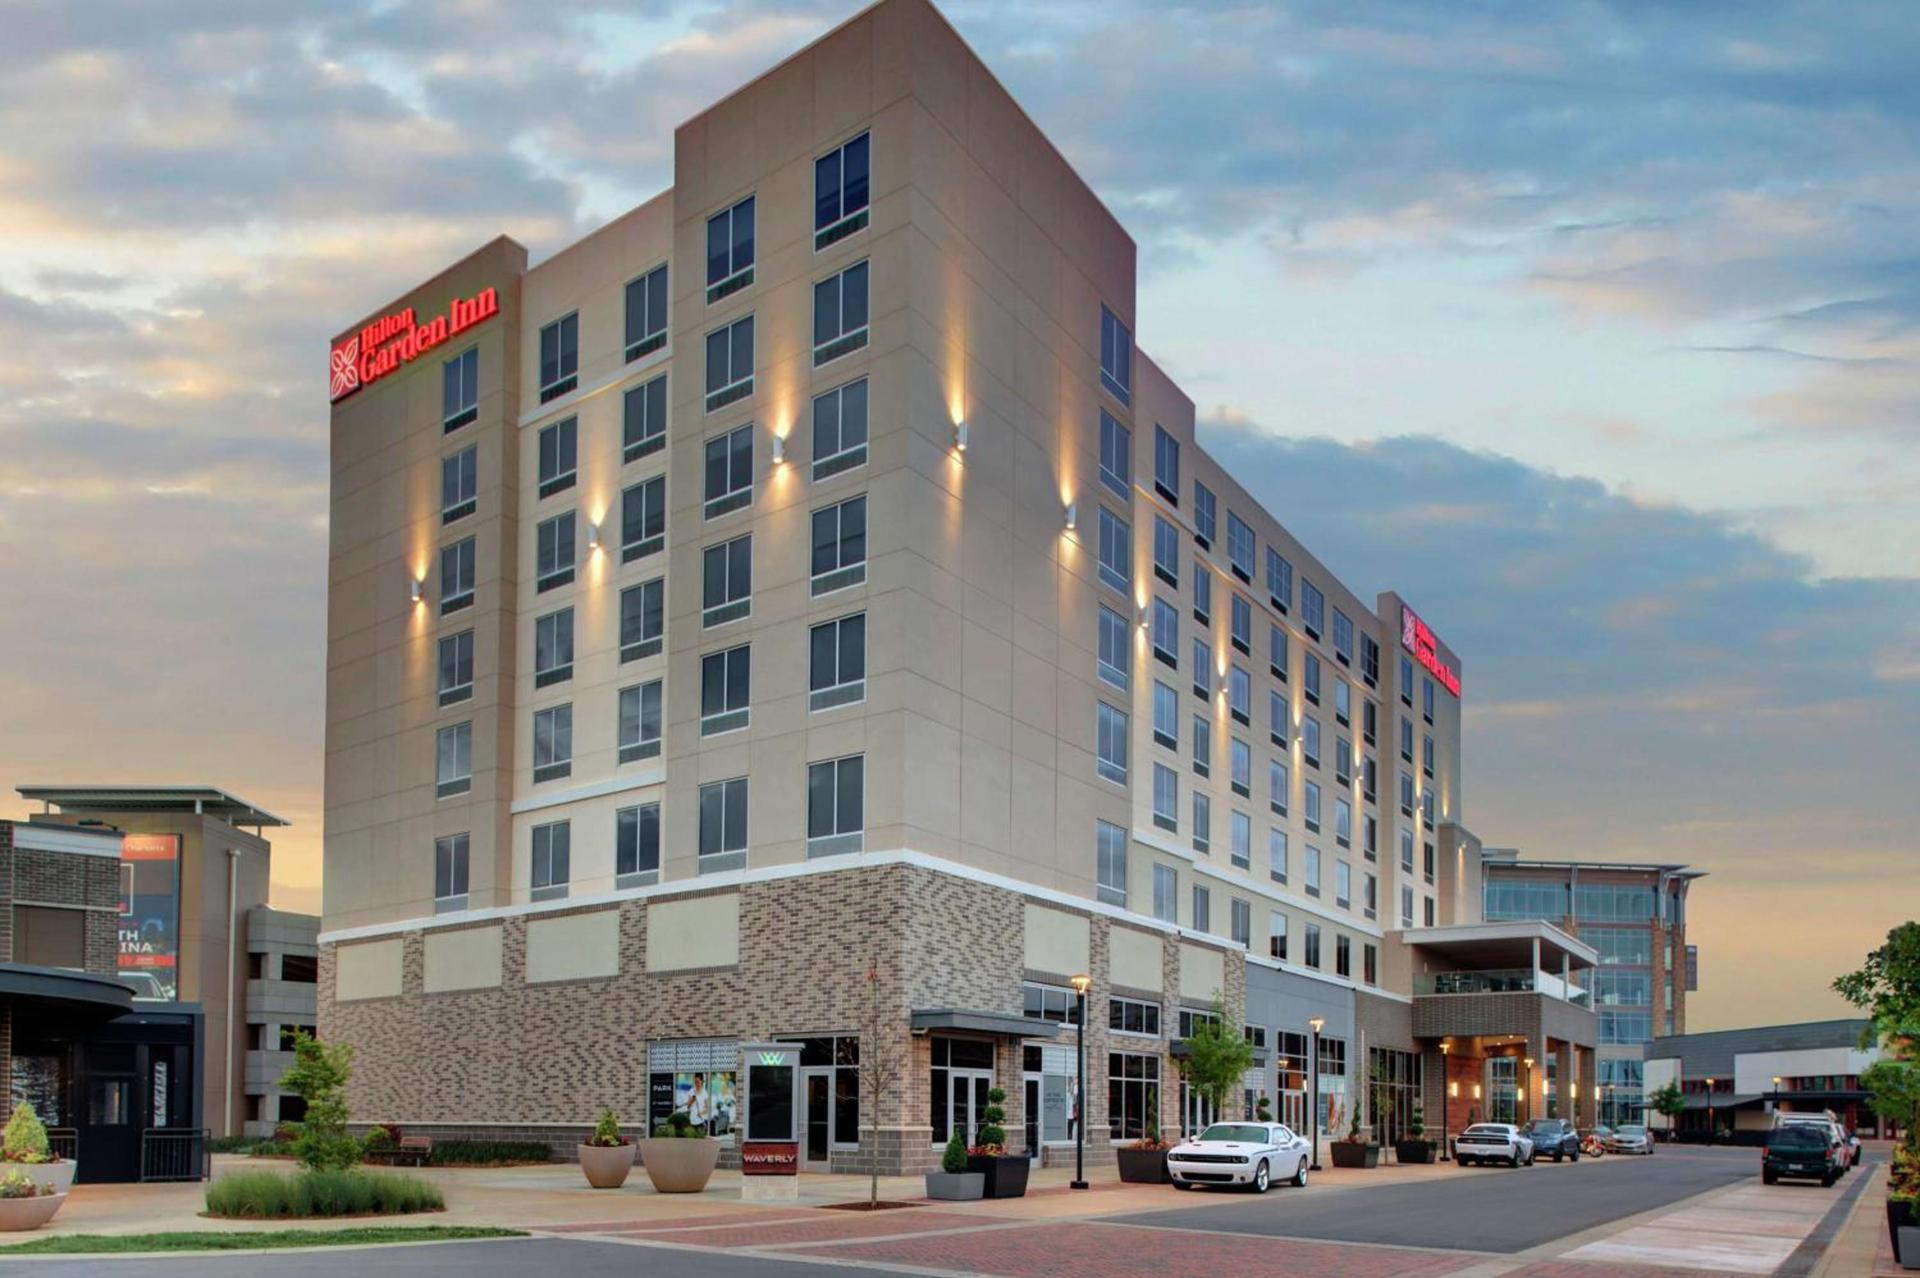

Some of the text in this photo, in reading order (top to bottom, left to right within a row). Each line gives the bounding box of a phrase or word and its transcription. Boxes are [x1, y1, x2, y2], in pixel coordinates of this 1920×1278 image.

[359, 286, 498, 383] Garden Inn
[360, 306, 415, 352] Hilton
[743, 1154, 796, 1163] WAVERLY
